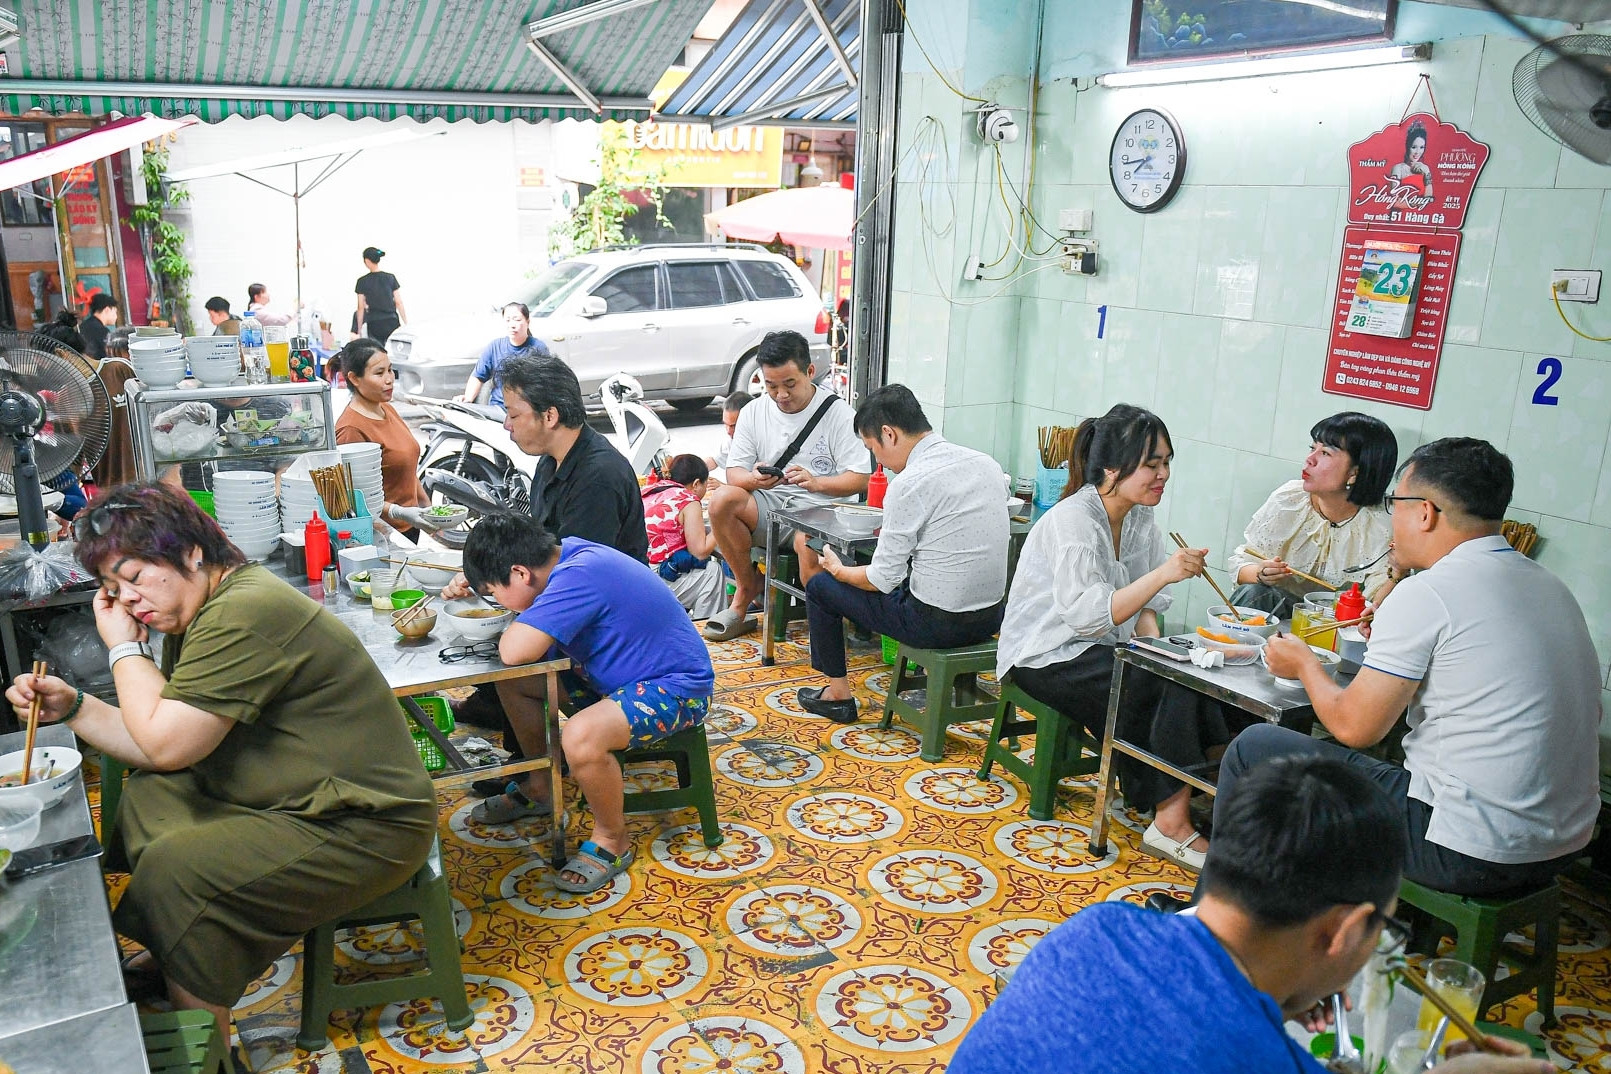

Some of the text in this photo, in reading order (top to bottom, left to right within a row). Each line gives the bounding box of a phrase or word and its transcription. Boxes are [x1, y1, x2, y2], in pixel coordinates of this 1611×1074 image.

[1134, 125, 1141, 134] 11
[1145, 120, 1154, 129] 12
[1161, 124, 1165, 134] 1
[1125, 138, 1134, 148] 10
[1166, 138, 1174, 147] 2
[1122, 154, 1129, 164] 9
[1168, 154, 1175, 164] 3
[1124, 171, 1131, 180] 8
[1163, 172, 1171, 180] 4
[1132, 184, 1138, 193] 7
[1141, 189, 1150, 198] 6
[1154, 184, 1162, 193] 5
[1391, 211, 1402, 221] 51
[1405, 212, 1429, 224] Hàng
[1432, 213, 1445, 224] Gà
[1373, 262, 1412, 297] 23
[1098, 305, 1107, 339] 1
[1352, 315, 1366, 327] 28
[1532, 357, 1563, 406] 2
